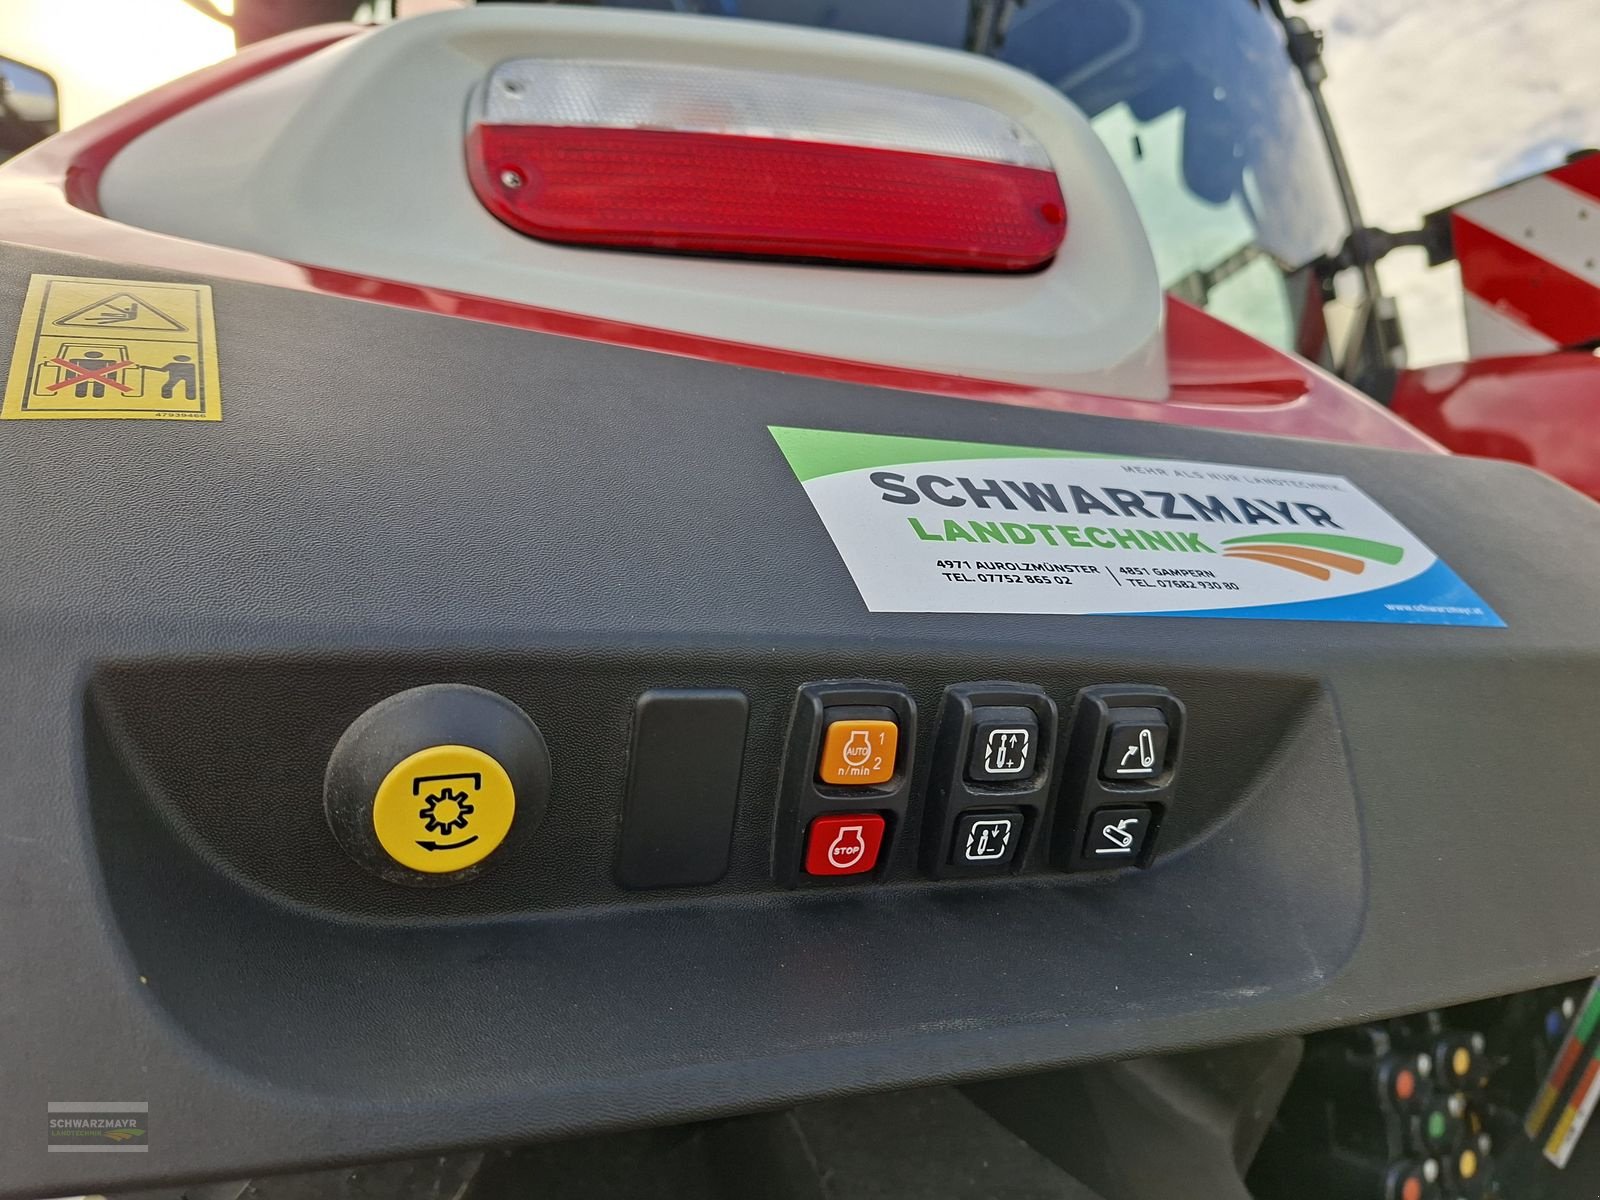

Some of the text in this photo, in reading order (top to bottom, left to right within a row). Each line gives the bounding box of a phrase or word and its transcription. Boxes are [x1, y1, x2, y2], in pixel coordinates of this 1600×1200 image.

[1120, 465, 1169, 477] MEHR
[1173, 469, 1205, 479] ALS
[1205, 472, 1240, 481] NUR
[869, 470, 1345, 530] SCHWARZMAYR
[907, 516, 1218, 555] LANDTECHNIK
[936, 559, 1101, 574] 4971 AUROLZMÜNSTER
[1119, 566, 1217, 578] 4851 GAMPERN
[942, 572, 1073, 585] TEL. 07752 865 02
[1156, 579, 1198, 589] 07682
[1197, 581, 1222, 590] 930
[1222, 582, 1240, 591] 80
[879, 731, 886, 745] 1
[845, 747, 869, 757] AUTO
[873, 757, 882, 770] 2
[838, 766, 870, 776] n/min
[833, 846, 860, 856] STOP
